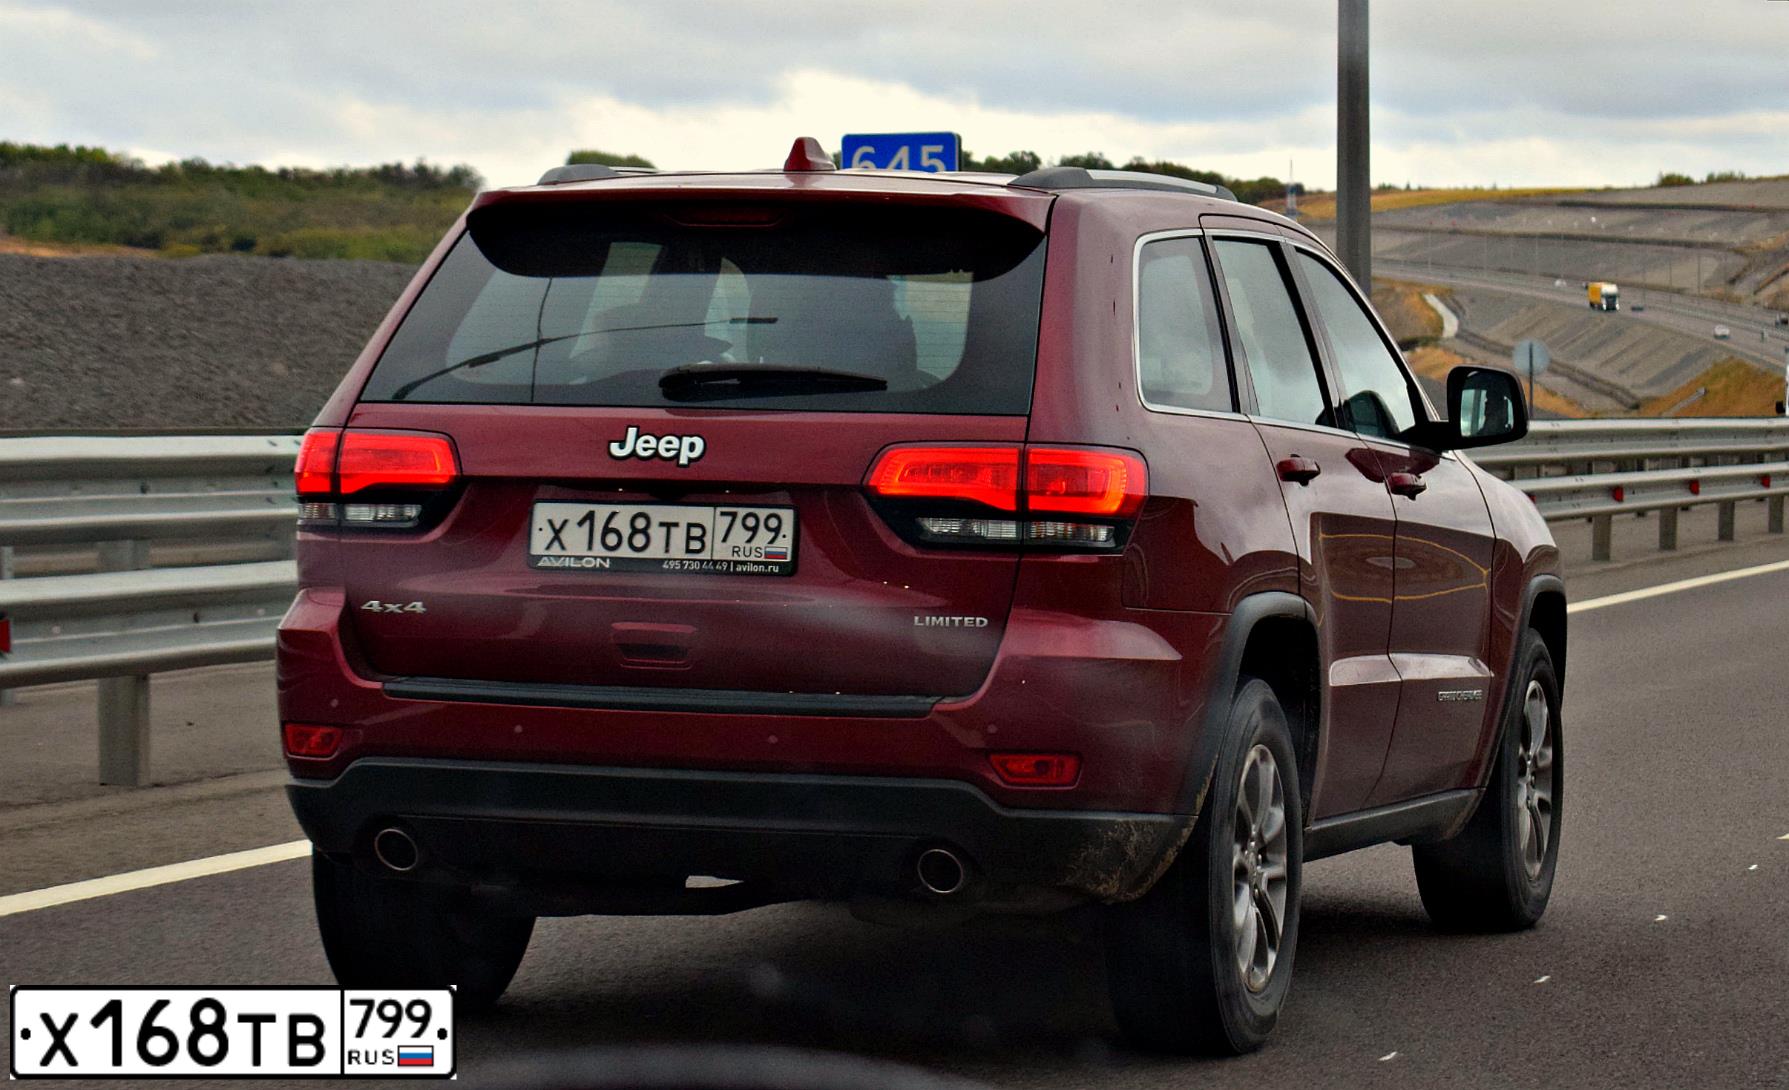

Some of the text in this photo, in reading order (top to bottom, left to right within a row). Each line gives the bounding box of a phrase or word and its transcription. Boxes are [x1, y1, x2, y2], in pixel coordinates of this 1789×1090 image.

[609, 426, 705, 466] Jeep
[545, 510, 783, 554] Х168ТВ 799
[732, 545, 763, 558] RUS
[537, 556, 610, 568] AVILON
[662, 560, 681, 570] 495
[682, 561, 700, 570] 730
[736, 562, 779, 573] avilon.ru
[360, 600, 427, 614] 4x4
[913, 616, 989, 628] LIMITED
